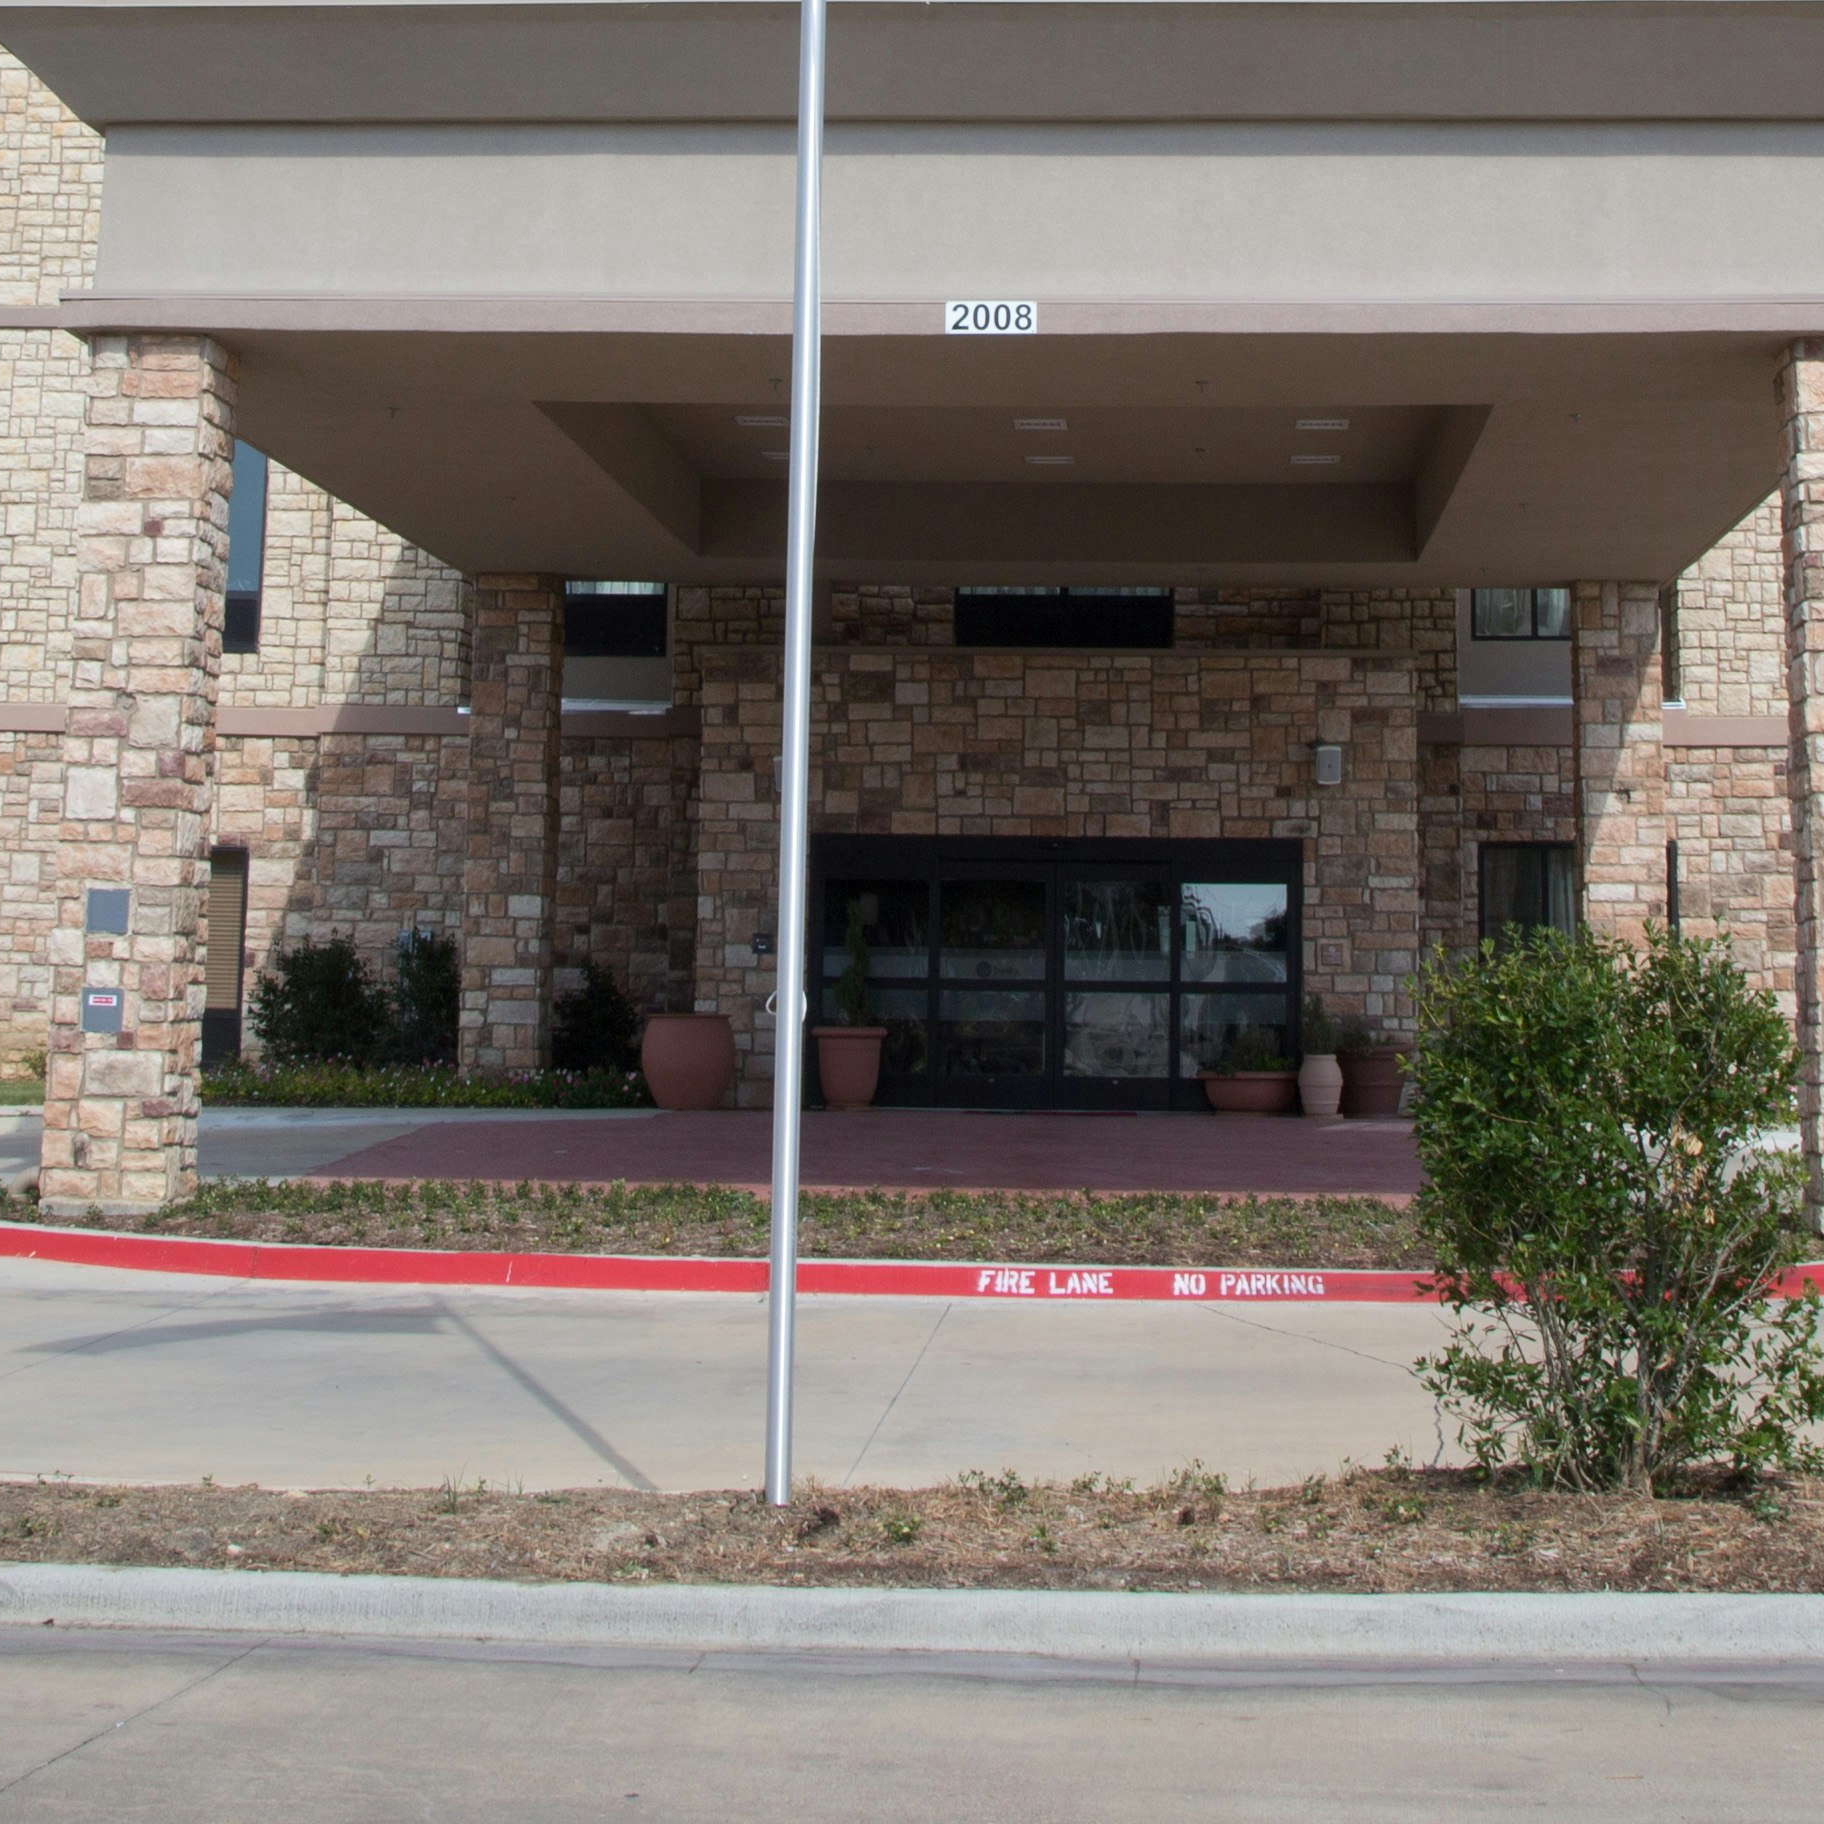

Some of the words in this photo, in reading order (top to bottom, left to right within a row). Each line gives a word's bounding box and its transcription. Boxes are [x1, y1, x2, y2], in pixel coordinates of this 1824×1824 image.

[951, 304, 1032, 331] 2008
[977, 1269, 1036, 1295] FIRE
[1048, 1271, 1114, 1295] LANE
[1173, 1272, 1207, 1296] NO
[1219, 1273, 1325, 1296] PARKING
